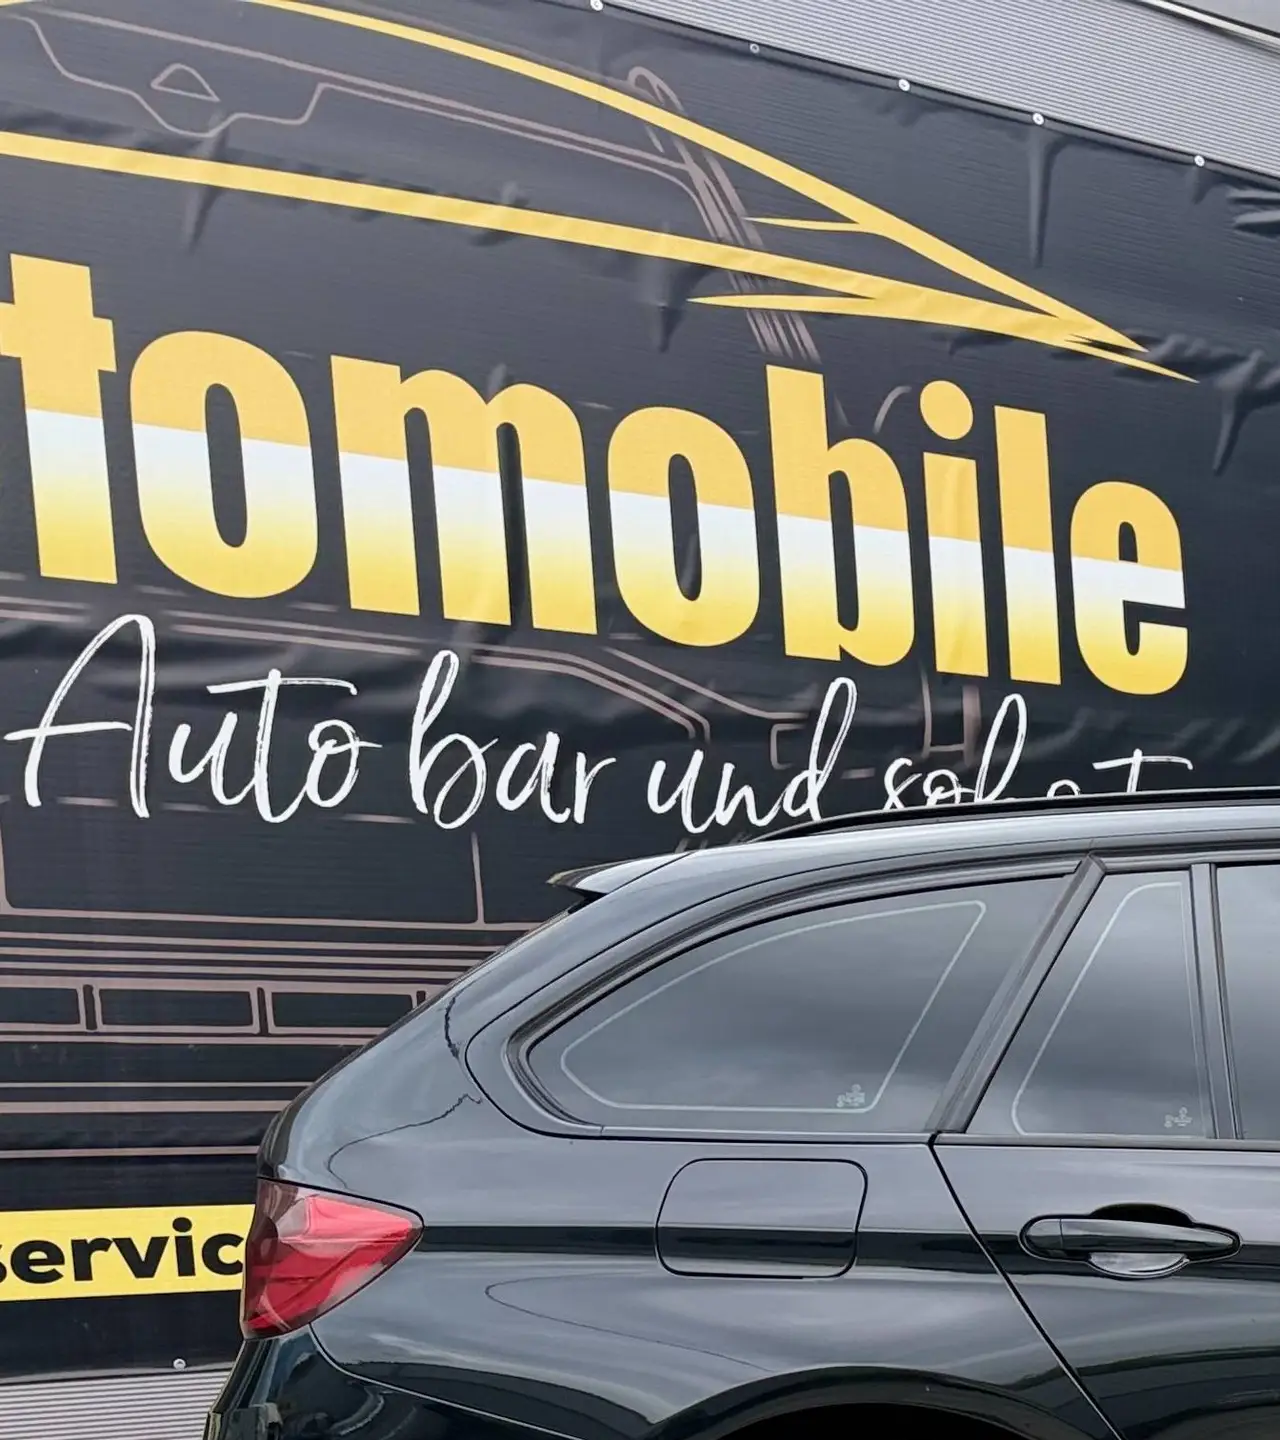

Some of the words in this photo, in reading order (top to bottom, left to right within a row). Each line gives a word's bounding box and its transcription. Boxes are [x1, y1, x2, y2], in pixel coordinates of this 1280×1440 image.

[4, 613, 382, 824] Auto
[409, 649, 617, 830] bar
[647, 676, 857, 834] und
[0, 1216, 244, 1285] ervic
